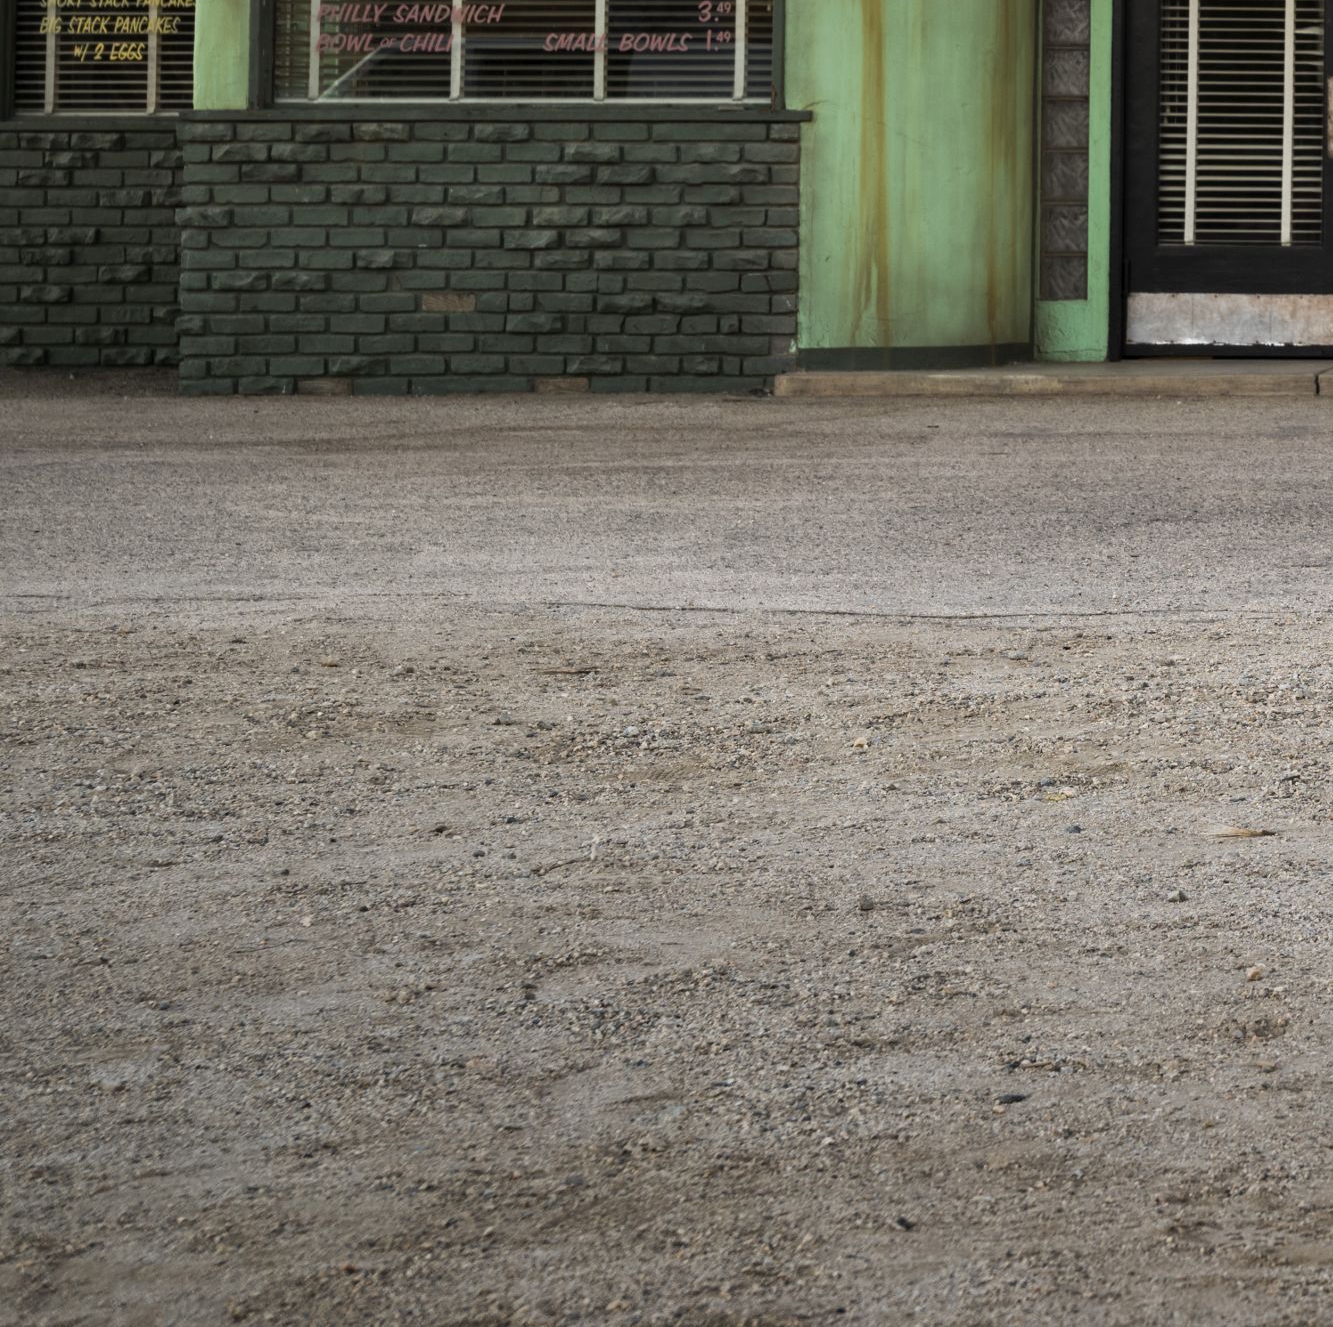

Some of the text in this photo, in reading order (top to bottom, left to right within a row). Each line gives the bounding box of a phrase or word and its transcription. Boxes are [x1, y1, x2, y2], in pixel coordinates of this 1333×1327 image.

[315, 0, 733, 24] PHILLY SANDWICH 3.49
[40, 16, 182, 35] BIG STACK PANCAKES
[315, 32, 375, 52] BOWL
[542, 32, 609, 52] SMALL
[618, 32, 694, 52] BOWLS
[705, 28, 732, 52] 1.49
[93, 42, 105, 61] 2
[109, 41, 147, 62] EGGS
